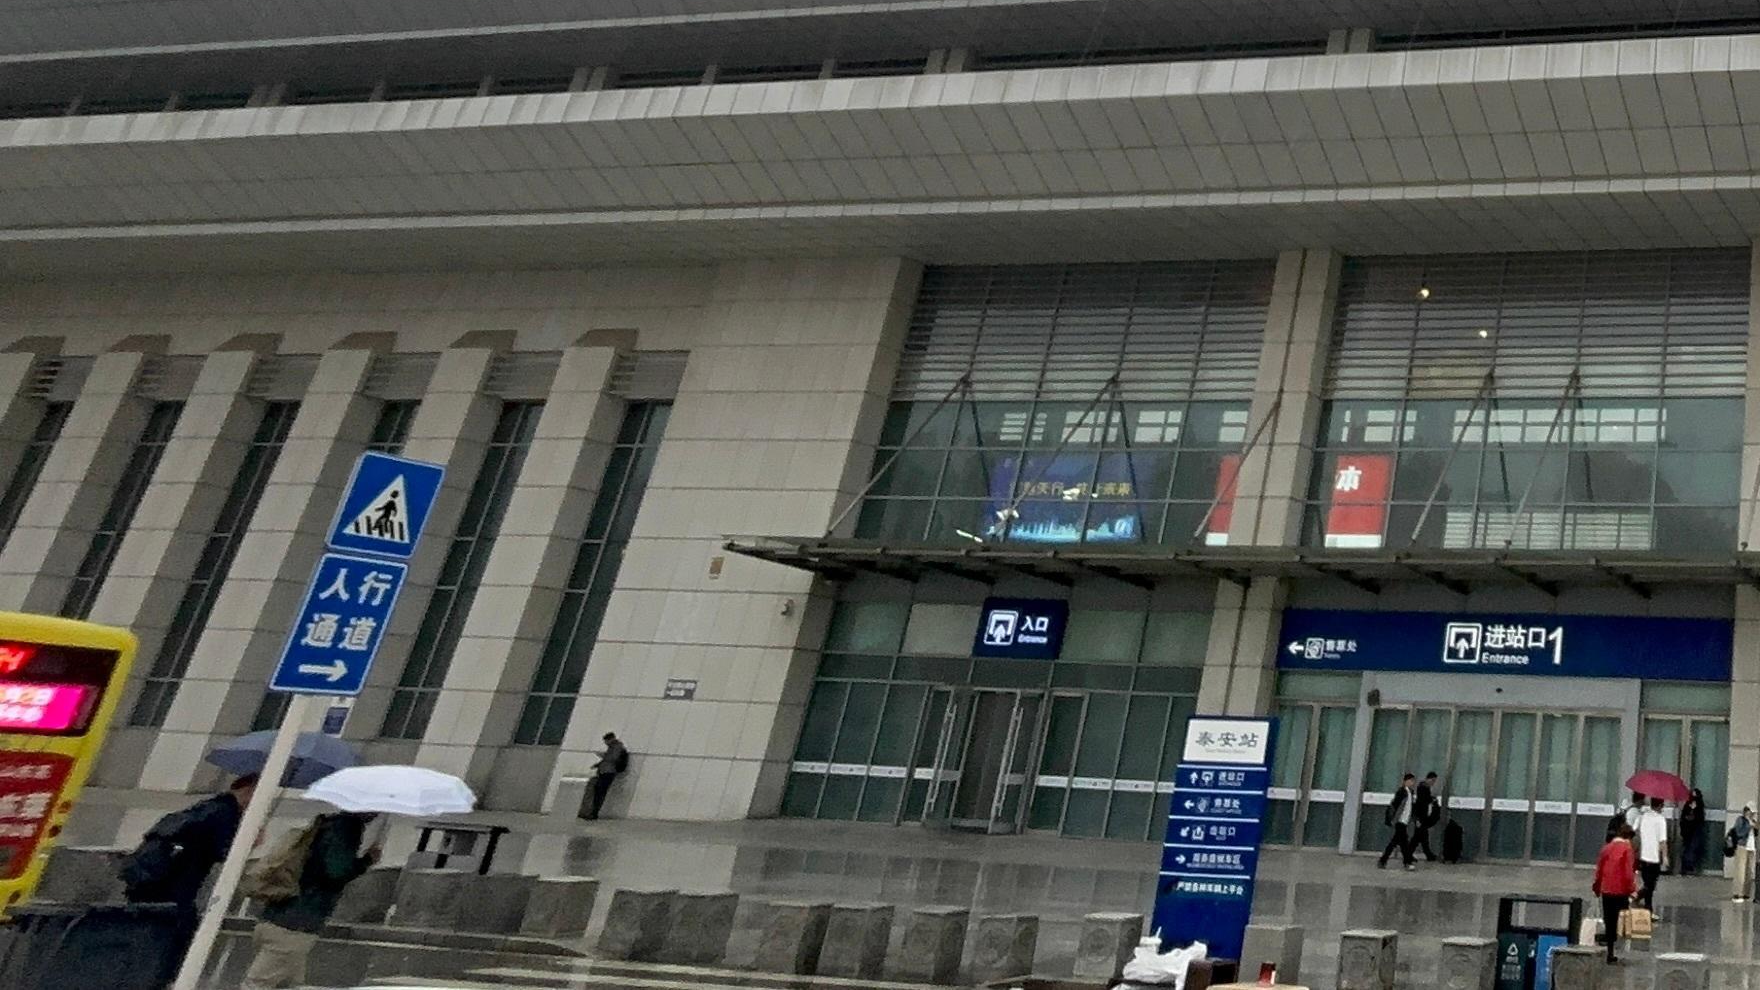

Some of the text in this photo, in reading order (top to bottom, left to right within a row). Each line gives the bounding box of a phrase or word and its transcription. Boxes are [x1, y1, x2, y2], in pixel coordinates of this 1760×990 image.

[319, 568, 393, 606] 人行
[301, 613, 377, 651] 通道
[1020, 616, 1049, 631] 入口
[1326, 639, 1357, 652] 售票处
[1484, 624, 1564, 665] 进站口 1
[1481, 651, 1529, 665] Entrance
[1195, 731, 1259, 748] 泰安站
